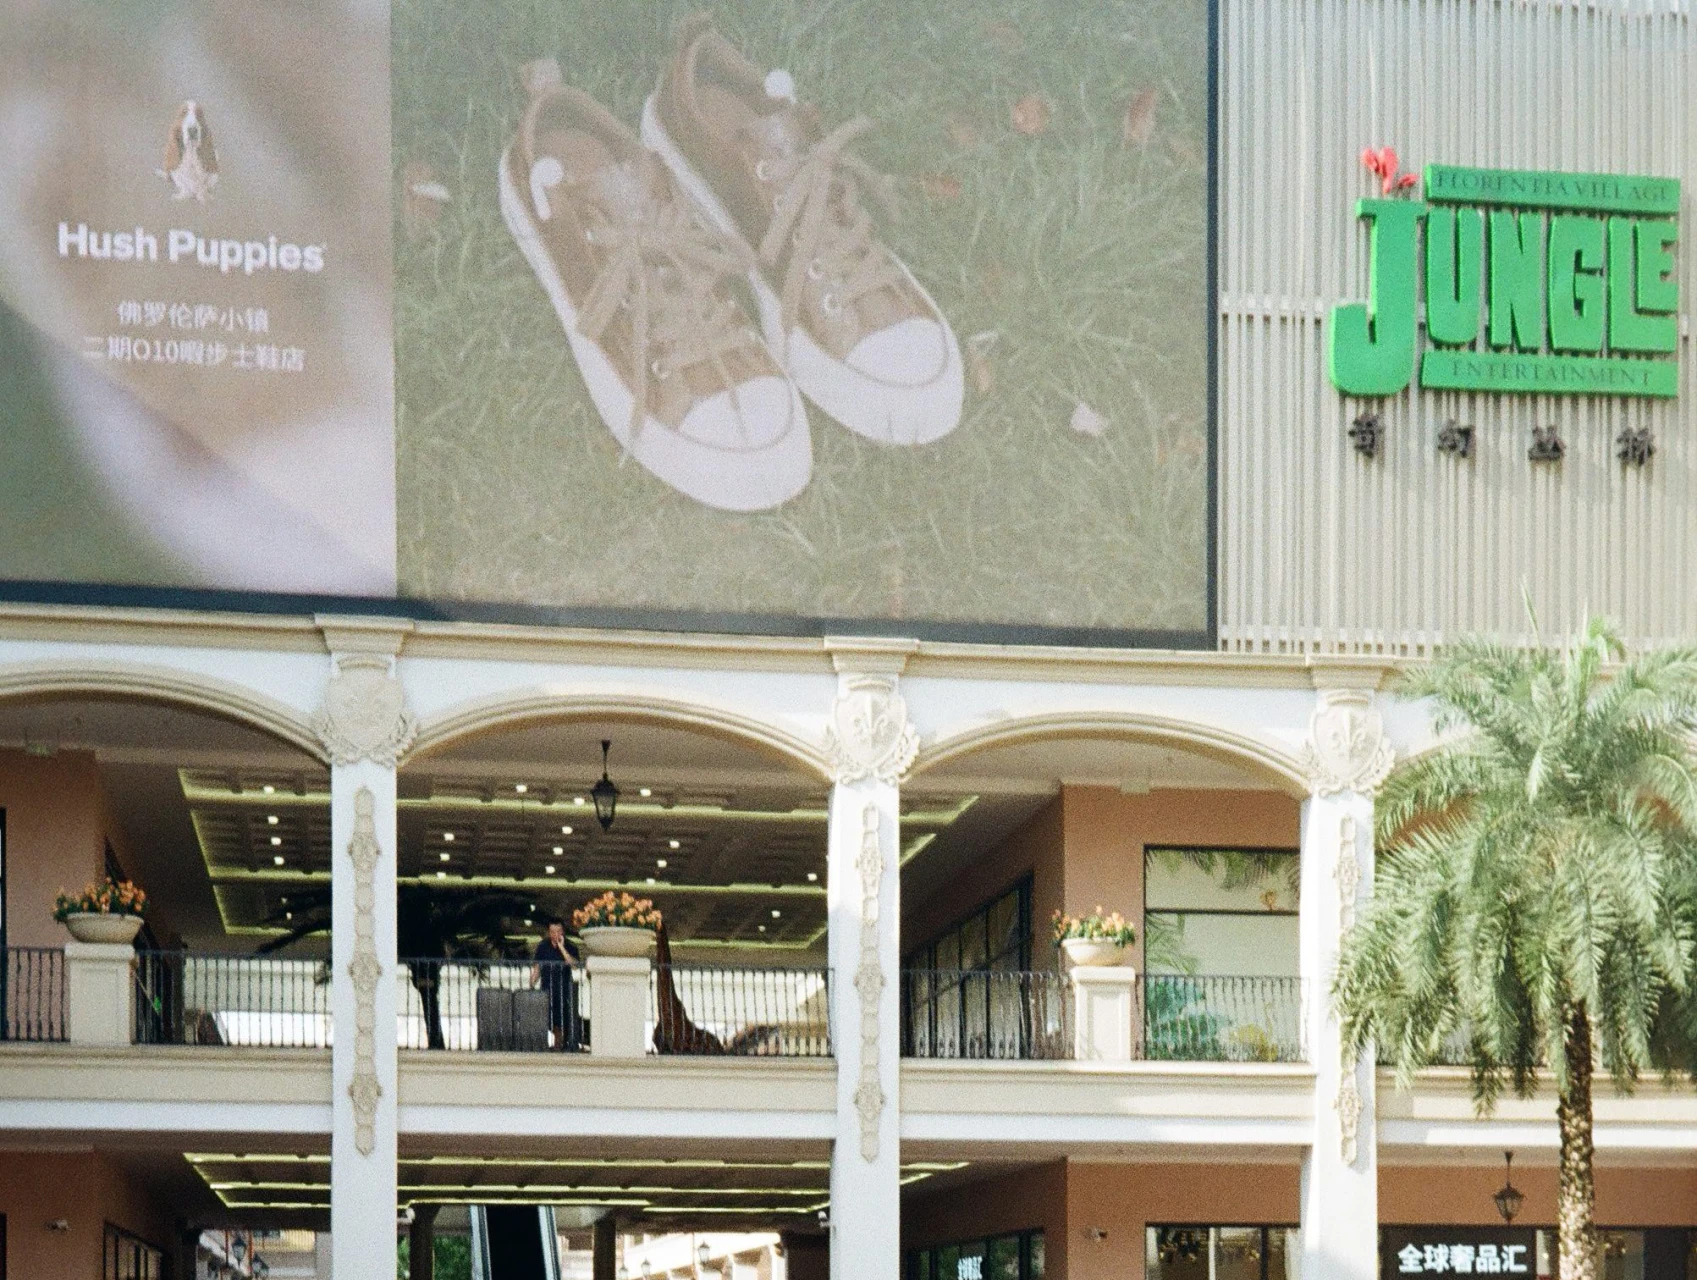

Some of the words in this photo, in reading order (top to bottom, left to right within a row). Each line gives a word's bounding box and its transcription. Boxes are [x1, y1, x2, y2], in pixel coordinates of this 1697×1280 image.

[58, 222, 157, 261] Hush
[168, 229, 324, 275] Puppies
[1328, 197, 1680, 396] JUNGLE
[1398, 1243, 1528, 1274] 全球奢品汇
